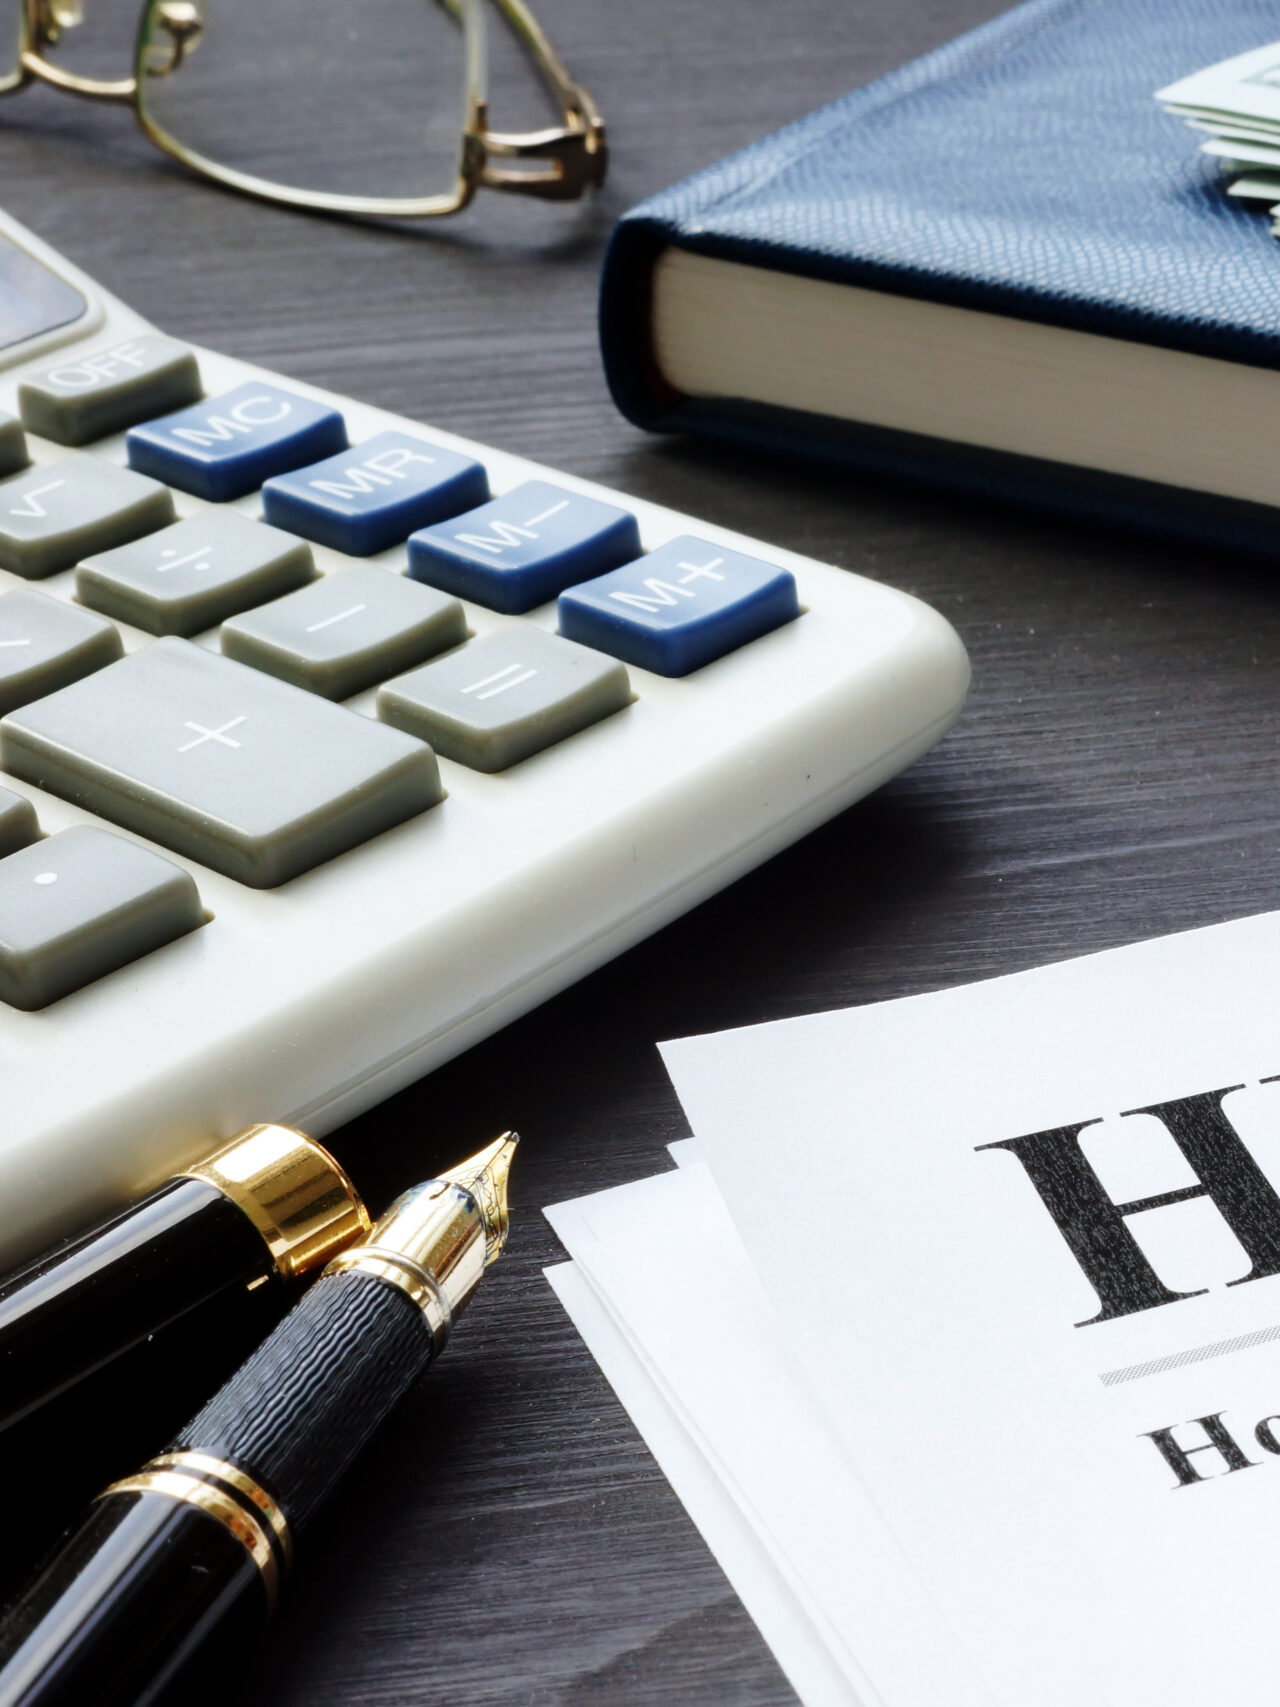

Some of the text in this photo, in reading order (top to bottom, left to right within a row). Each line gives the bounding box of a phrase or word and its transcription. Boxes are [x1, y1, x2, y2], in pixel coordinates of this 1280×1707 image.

[48, 341, 146, 388] OFF
[171, 396, 292, 447] MC
[308, 448, 437, 500] MR
[608, 557, 727, 614] M+
